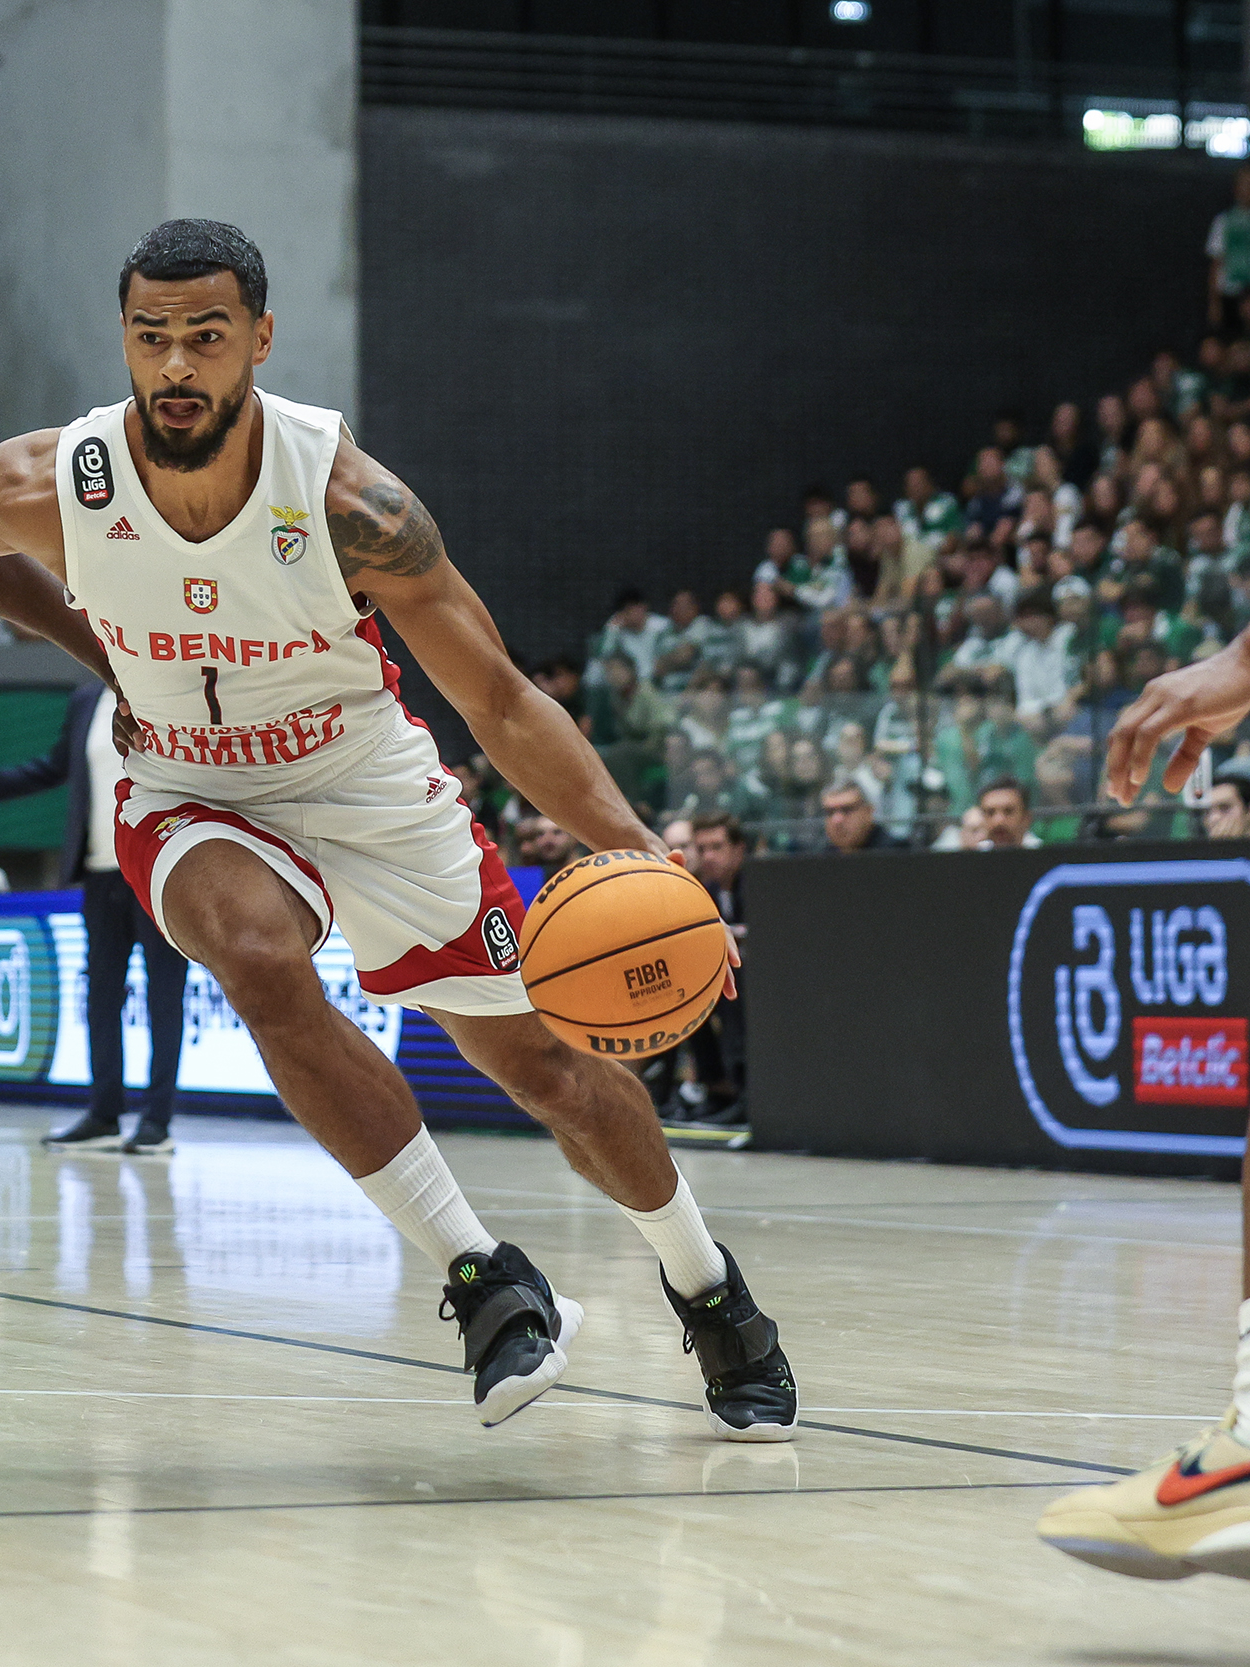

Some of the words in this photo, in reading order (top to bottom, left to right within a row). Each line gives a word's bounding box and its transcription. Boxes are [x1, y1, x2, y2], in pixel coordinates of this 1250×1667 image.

[106, 531, 141, 540] adidas
[99, 618, 139, 657] SL
[200, 665, 223, 725] 1
[623, 958, 670, 990] FIBA
[629, 979, 673, 1000] APPROVED
[586, 998, 716, 1055] Wilson
